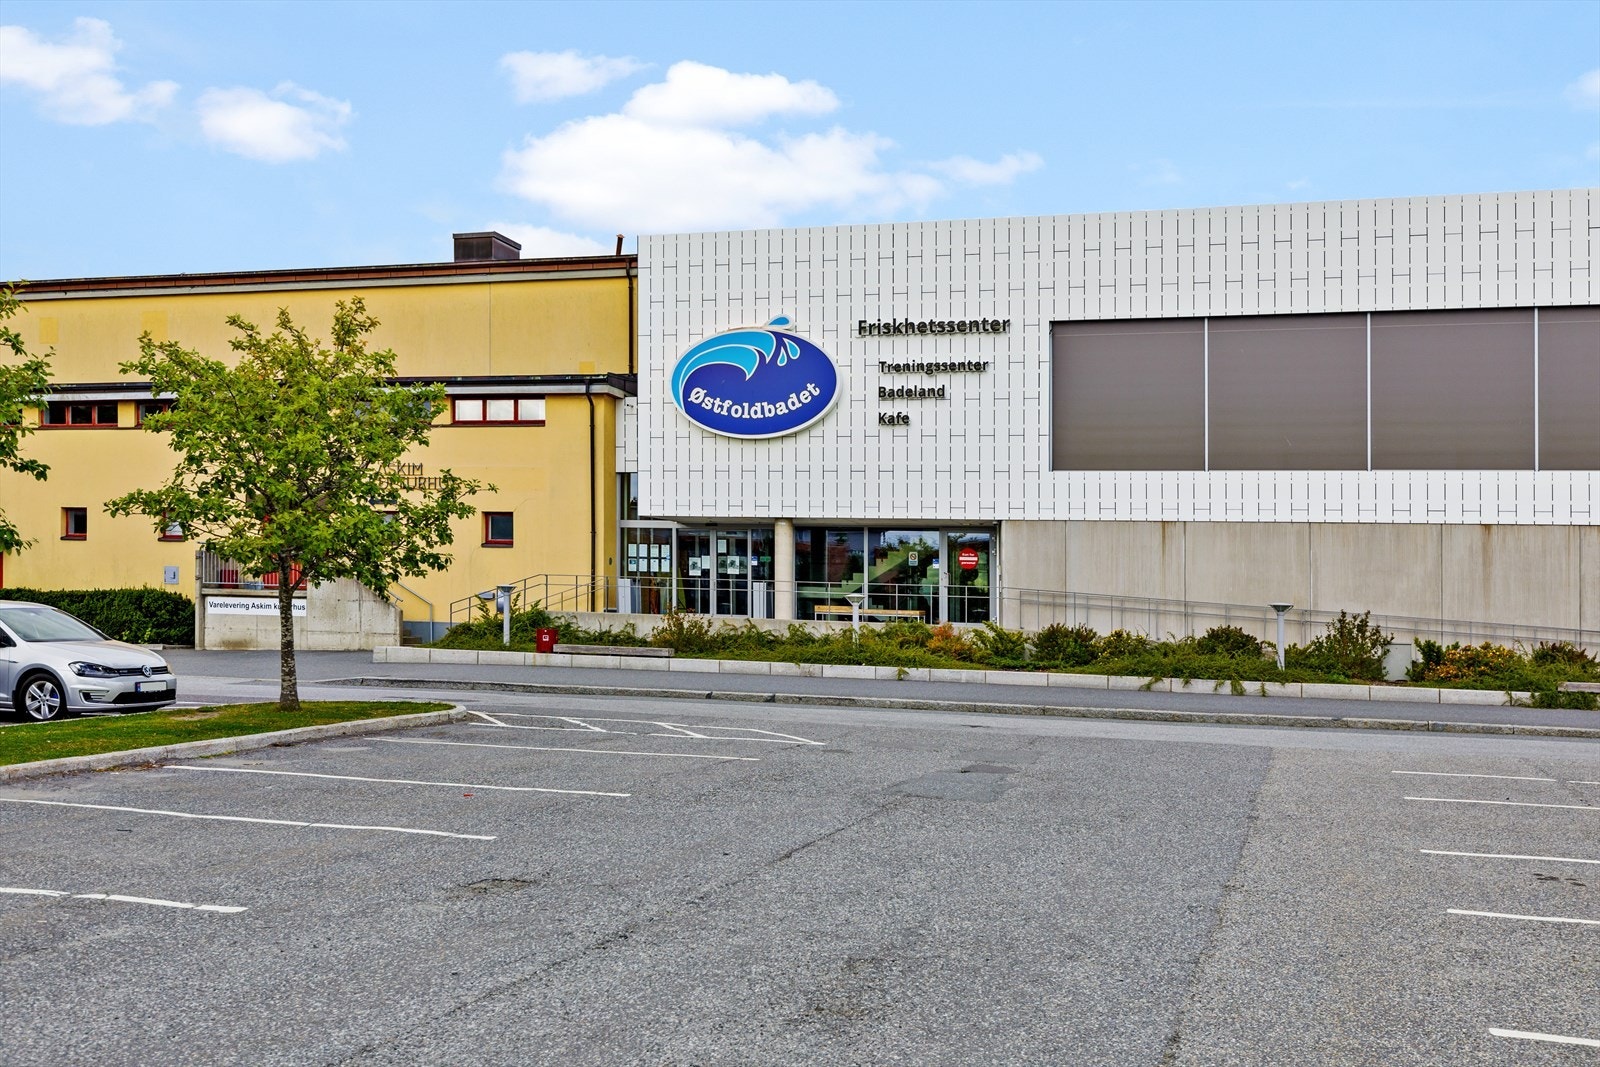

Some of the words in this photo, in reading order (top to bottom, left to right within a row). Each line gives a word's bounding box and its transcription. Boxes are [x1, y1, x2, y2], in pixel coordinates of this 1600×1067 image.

[857, 317, 1011, 334] Friskhetssenter
[878, 360, 989, 376] Treningssenter
[878, 384, 946, 398] Badeland
[687, 382, 821, 419] Østfoldbadet
[878, 411, 911, 425] Kafe
[208, 601, 250, 611] Varelevering
[250, 602, 272, 610] Askim
